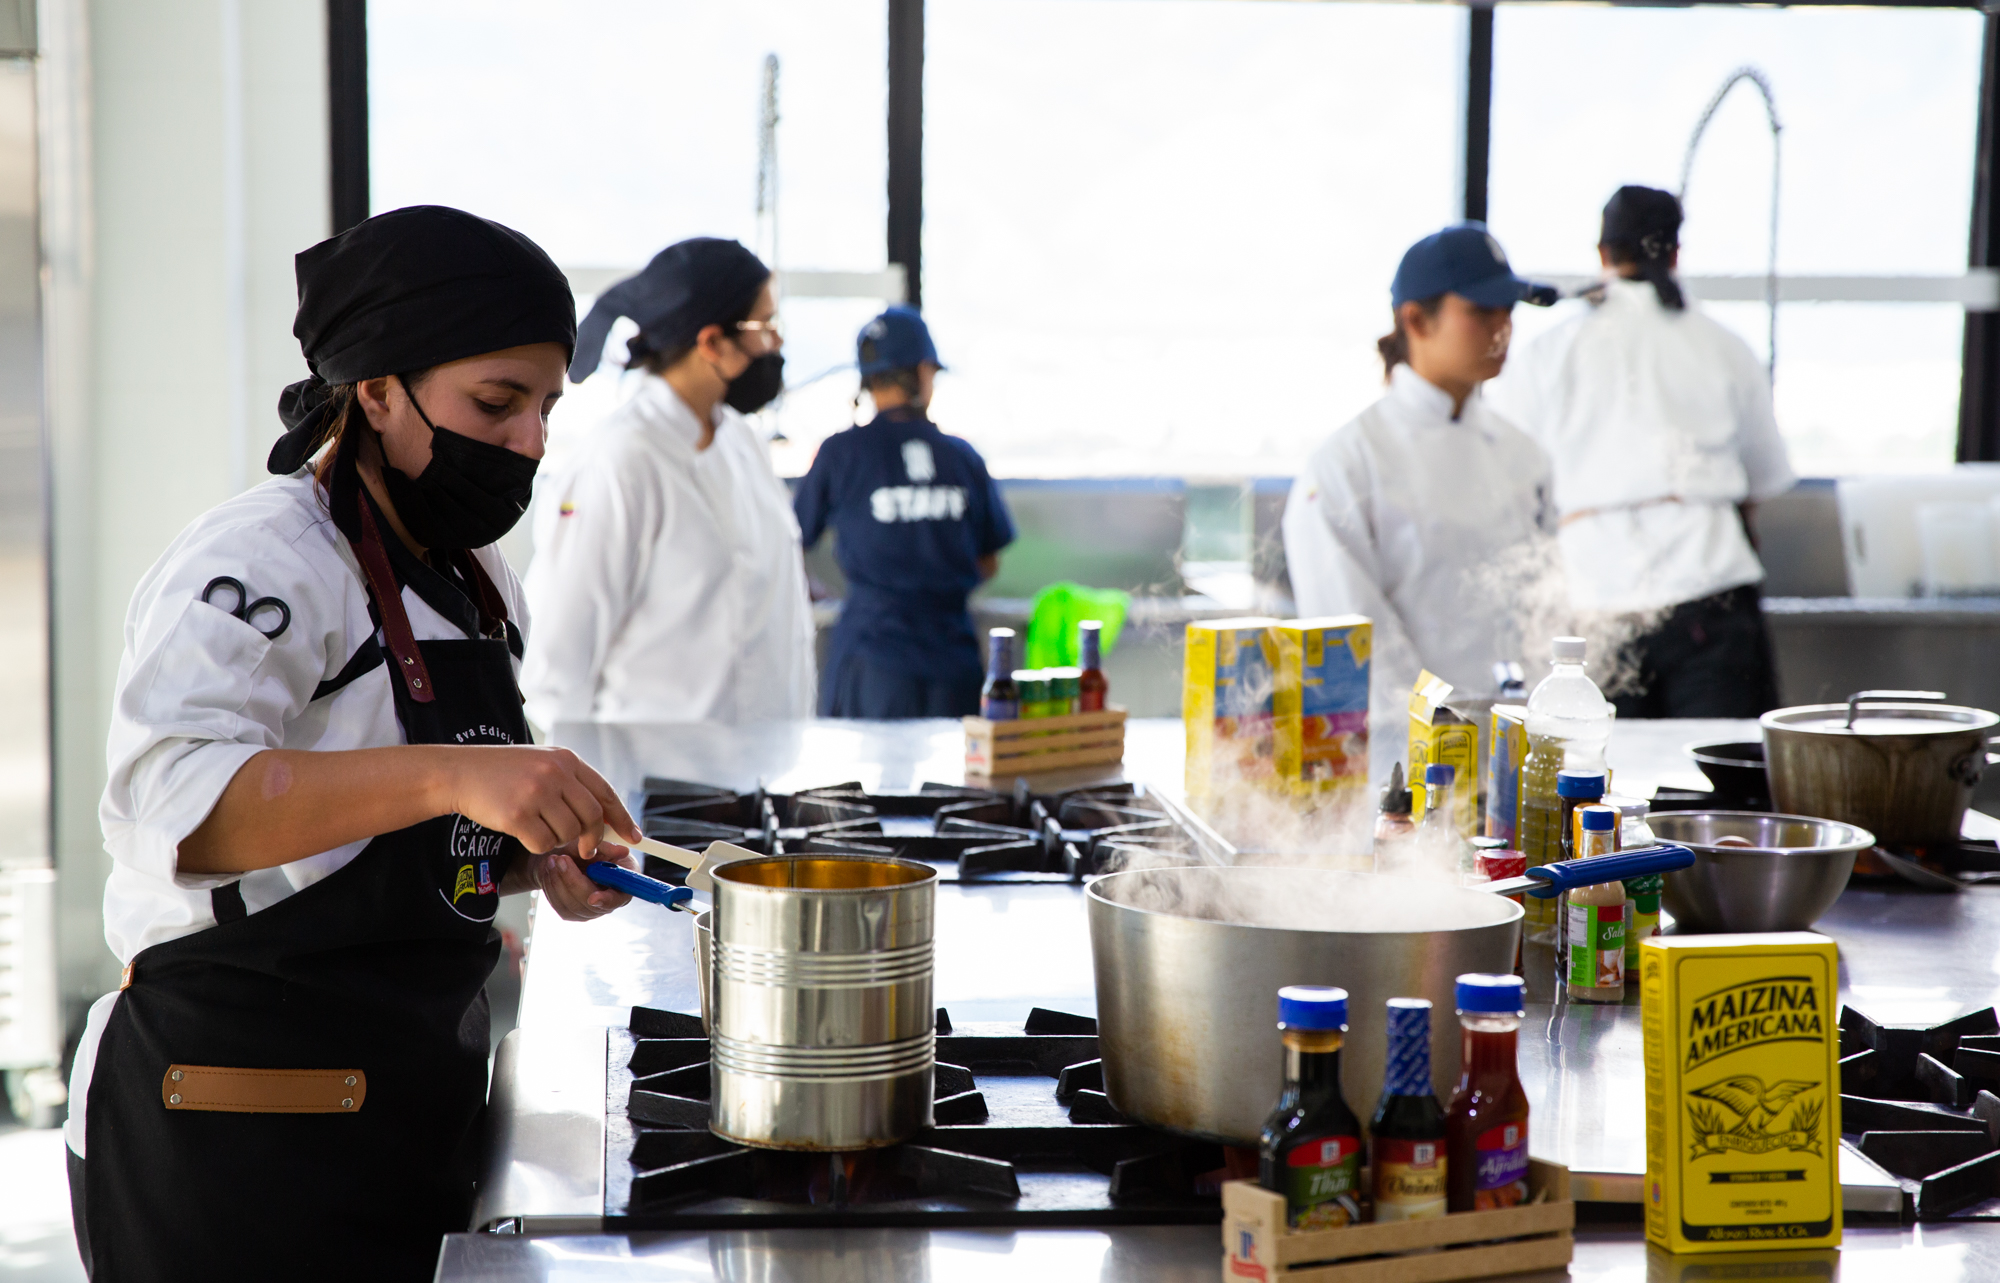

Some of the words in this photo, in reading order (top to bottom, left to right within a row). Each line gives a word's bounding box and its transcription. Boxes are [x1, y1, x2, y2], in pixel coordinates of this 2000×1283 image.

[455, 728, 476, 743] 8va
[457, 835, 503, 857] CARTA
[1689, 984, 1818, 1039] MAIZINA
[1685, 1013, 1823, 1069] AMERICANA
